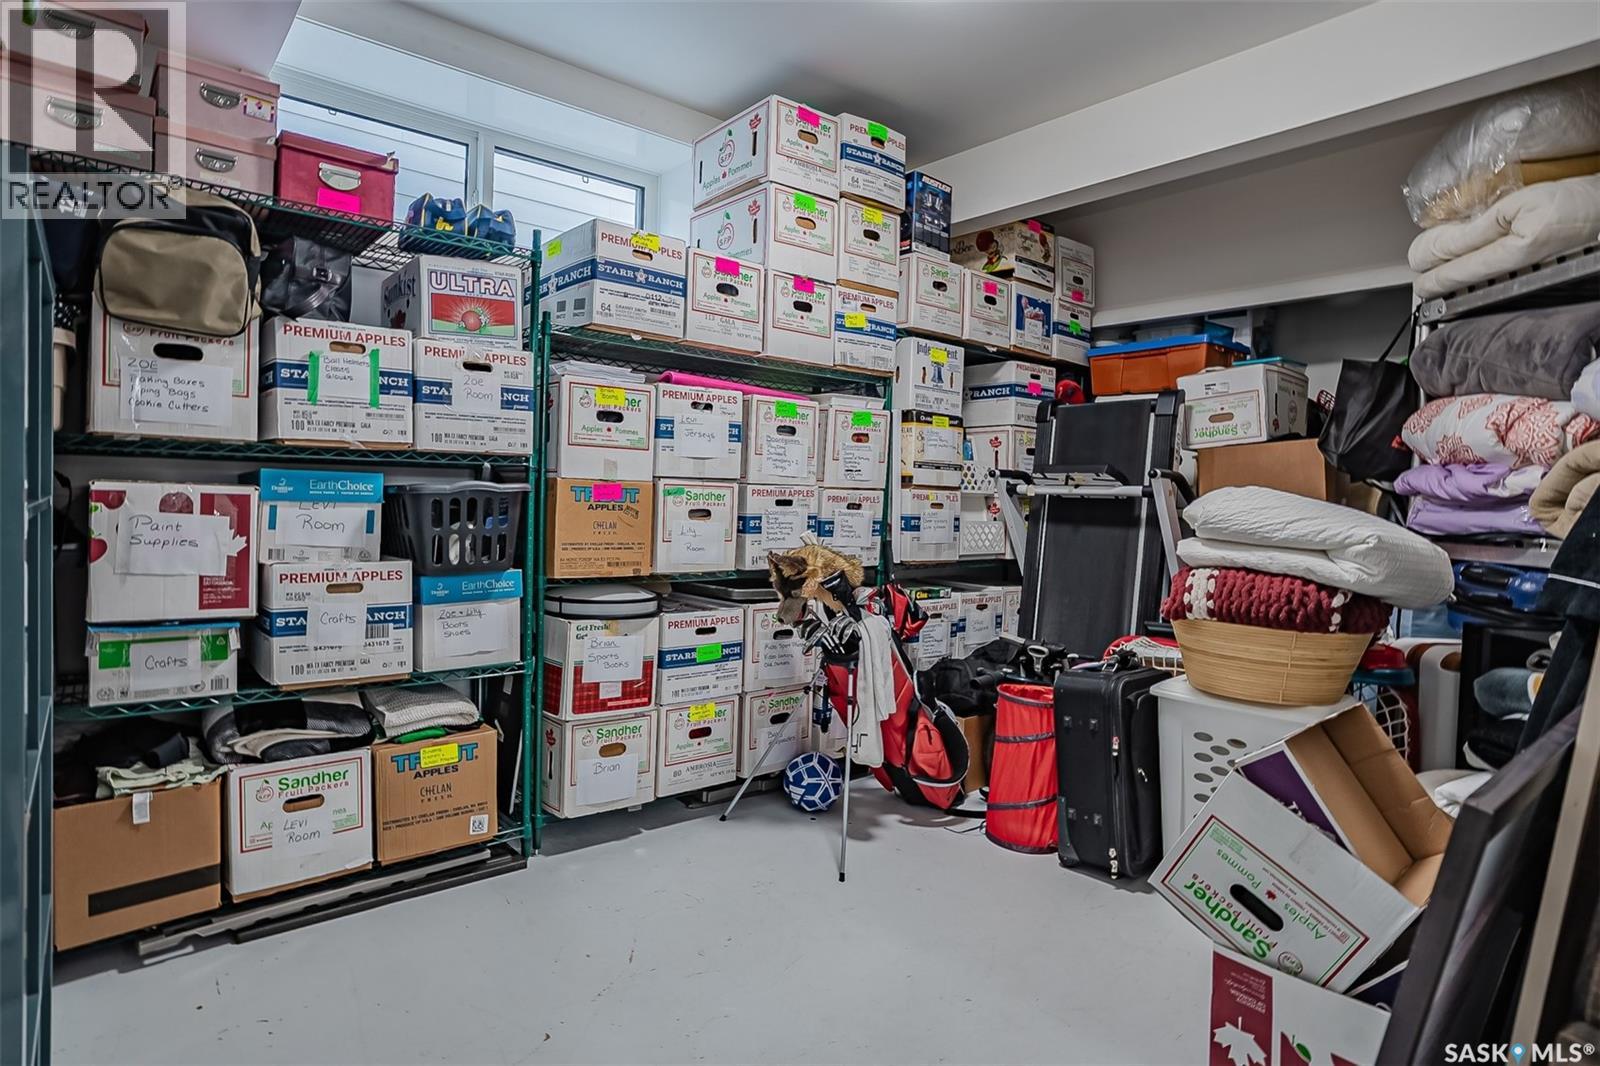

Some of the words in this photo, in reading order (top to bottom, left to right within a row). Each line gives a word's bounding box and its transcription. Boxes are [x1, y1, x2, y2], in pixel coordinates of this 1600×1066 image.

[598, 264, 634, 278] STARR
[648, 275, 684, 289] RANCH
[430, 271, 515, 297] ULTRA
[600, 303, 611, 312] 64
[283, 324, 351, 341] PREMIUM
[355, 332, 406, 347] APPLES
[484, 353, 527, 366] APPLES
[379, 376, 408, 387] NCH
[503, 391, 530, 402] NCH
[662, 390, 704, 401] PREMIUM
[706, 395, 738, 405] APPLES
[970, 387, 1010, 398] RANCH
[581, 424, 603, 434] Apples
[1194, 426, 1238, 439] Sandher
[309, 479, 374, 492] EarthChoice
[685, 490, 726, 502] Sandher
[751, 488, 786, 498] PREMIUM
[788, 489, 815, 498] APPLES
[587, 503, 624, 512] APPLES
[129, 515, 182, 533] Paint
[296, 514, 345, 533] Room
[129, 534, 199, 550] Supplies
[279, 572, 348, 585] PREMIUM
[352, 570, 403, 582] APPLES
[275, 618, 307, 627] STA
[367, 611, 406, 622] ANCH
[320, 612, 357, 625] Crafts
[668, 618, 708, 630] PREMIUM
[710, 615, 740, 625] APPLES
[590, 639, 618, 649] Brian
[722, 646, 740, 655] NCH
[145, 655, 188, 670] Crafts
[588, 653, 619, 664] Sports
[768, 696, 800, 708] Sandhe
[596, 724, 642, 740] Sandher
[413, 765, 459, 780] APPLES
[593, 762, 620, 775] Brian
[278, 769, 349, 792] Sandher
[307, 781, 349, 793] Packers
[420, 783, 453, 797] CHELAN
[286, 830, 321, 844] Room
[1217, 848, 1264, 889] Pommes
[1184, 880, 1272, 960] Sandher
[1283, 902, 1326, 940] Apples
